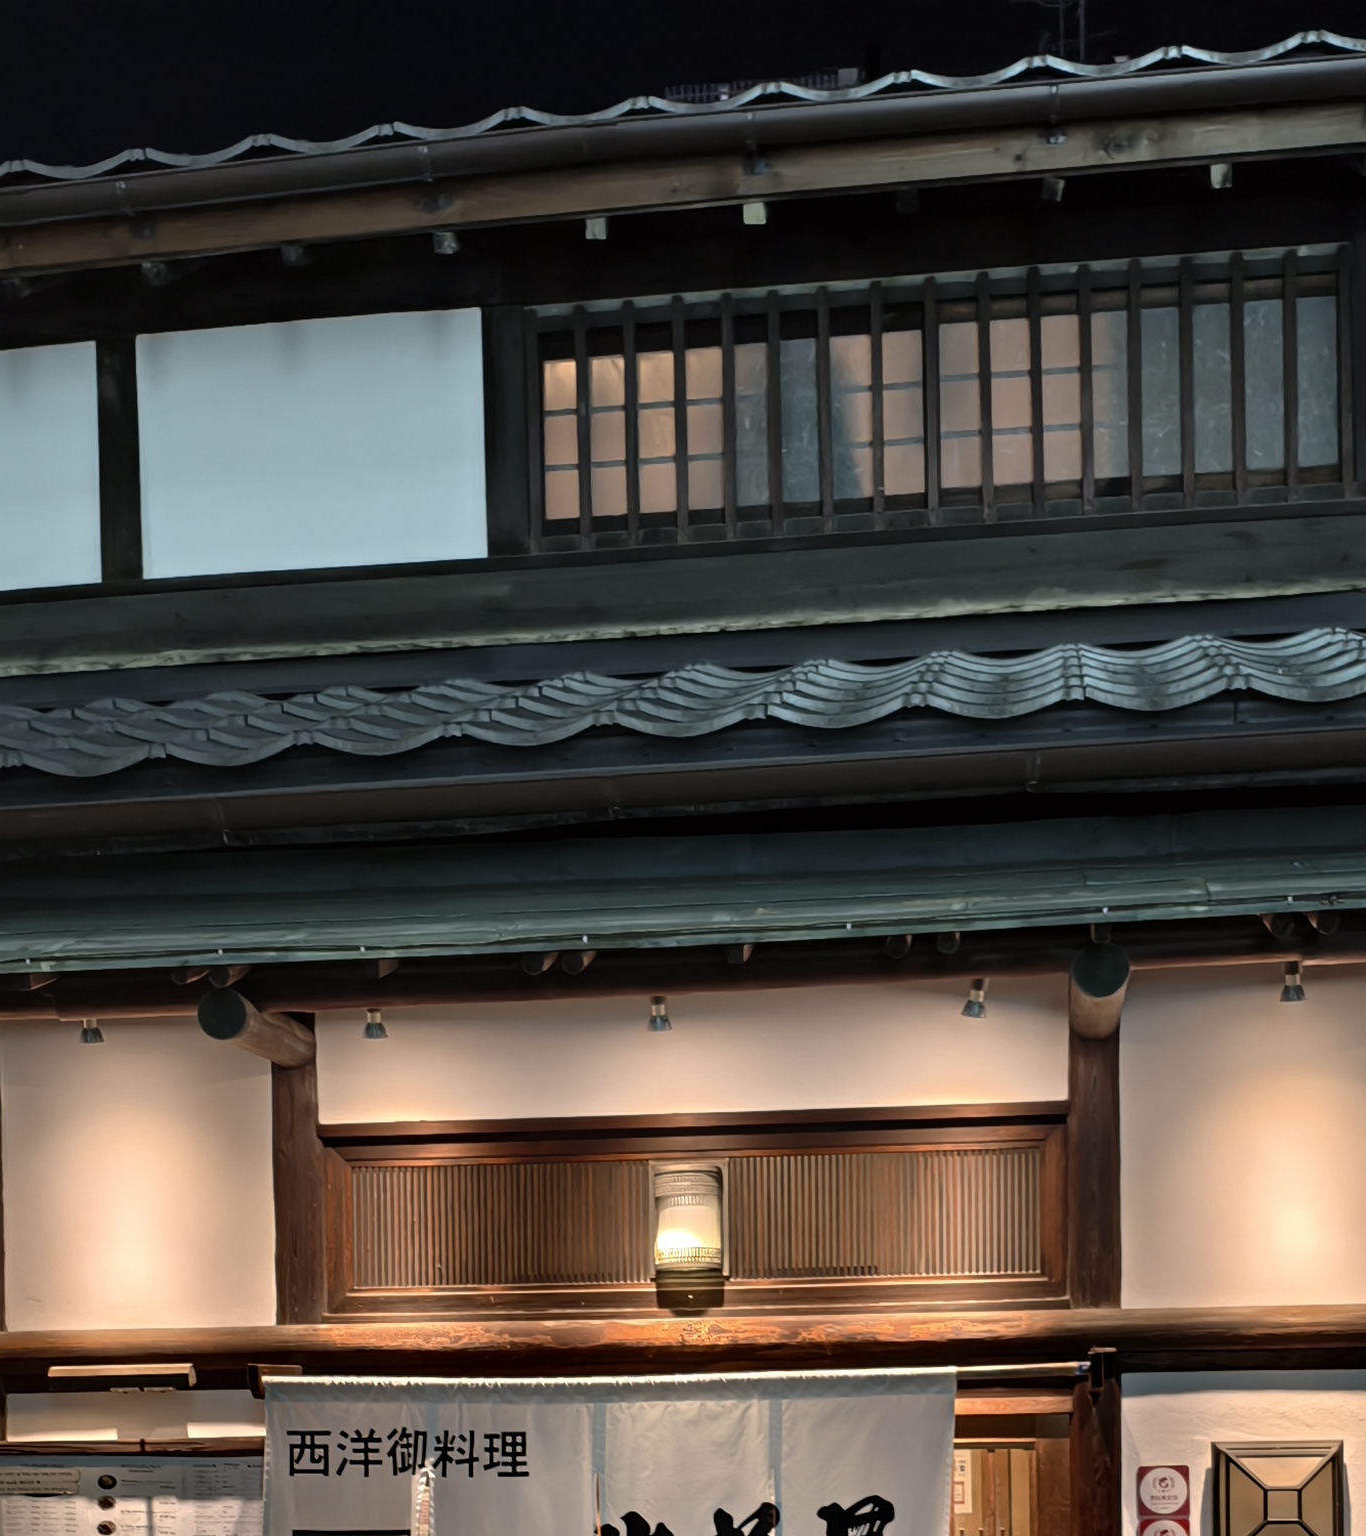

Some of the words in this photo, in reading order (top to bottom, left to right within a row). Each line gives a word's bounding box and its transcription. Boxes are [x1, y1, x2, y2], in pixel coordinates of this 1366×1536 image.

[286, 1428, 531, 1478] 西洋御料理
